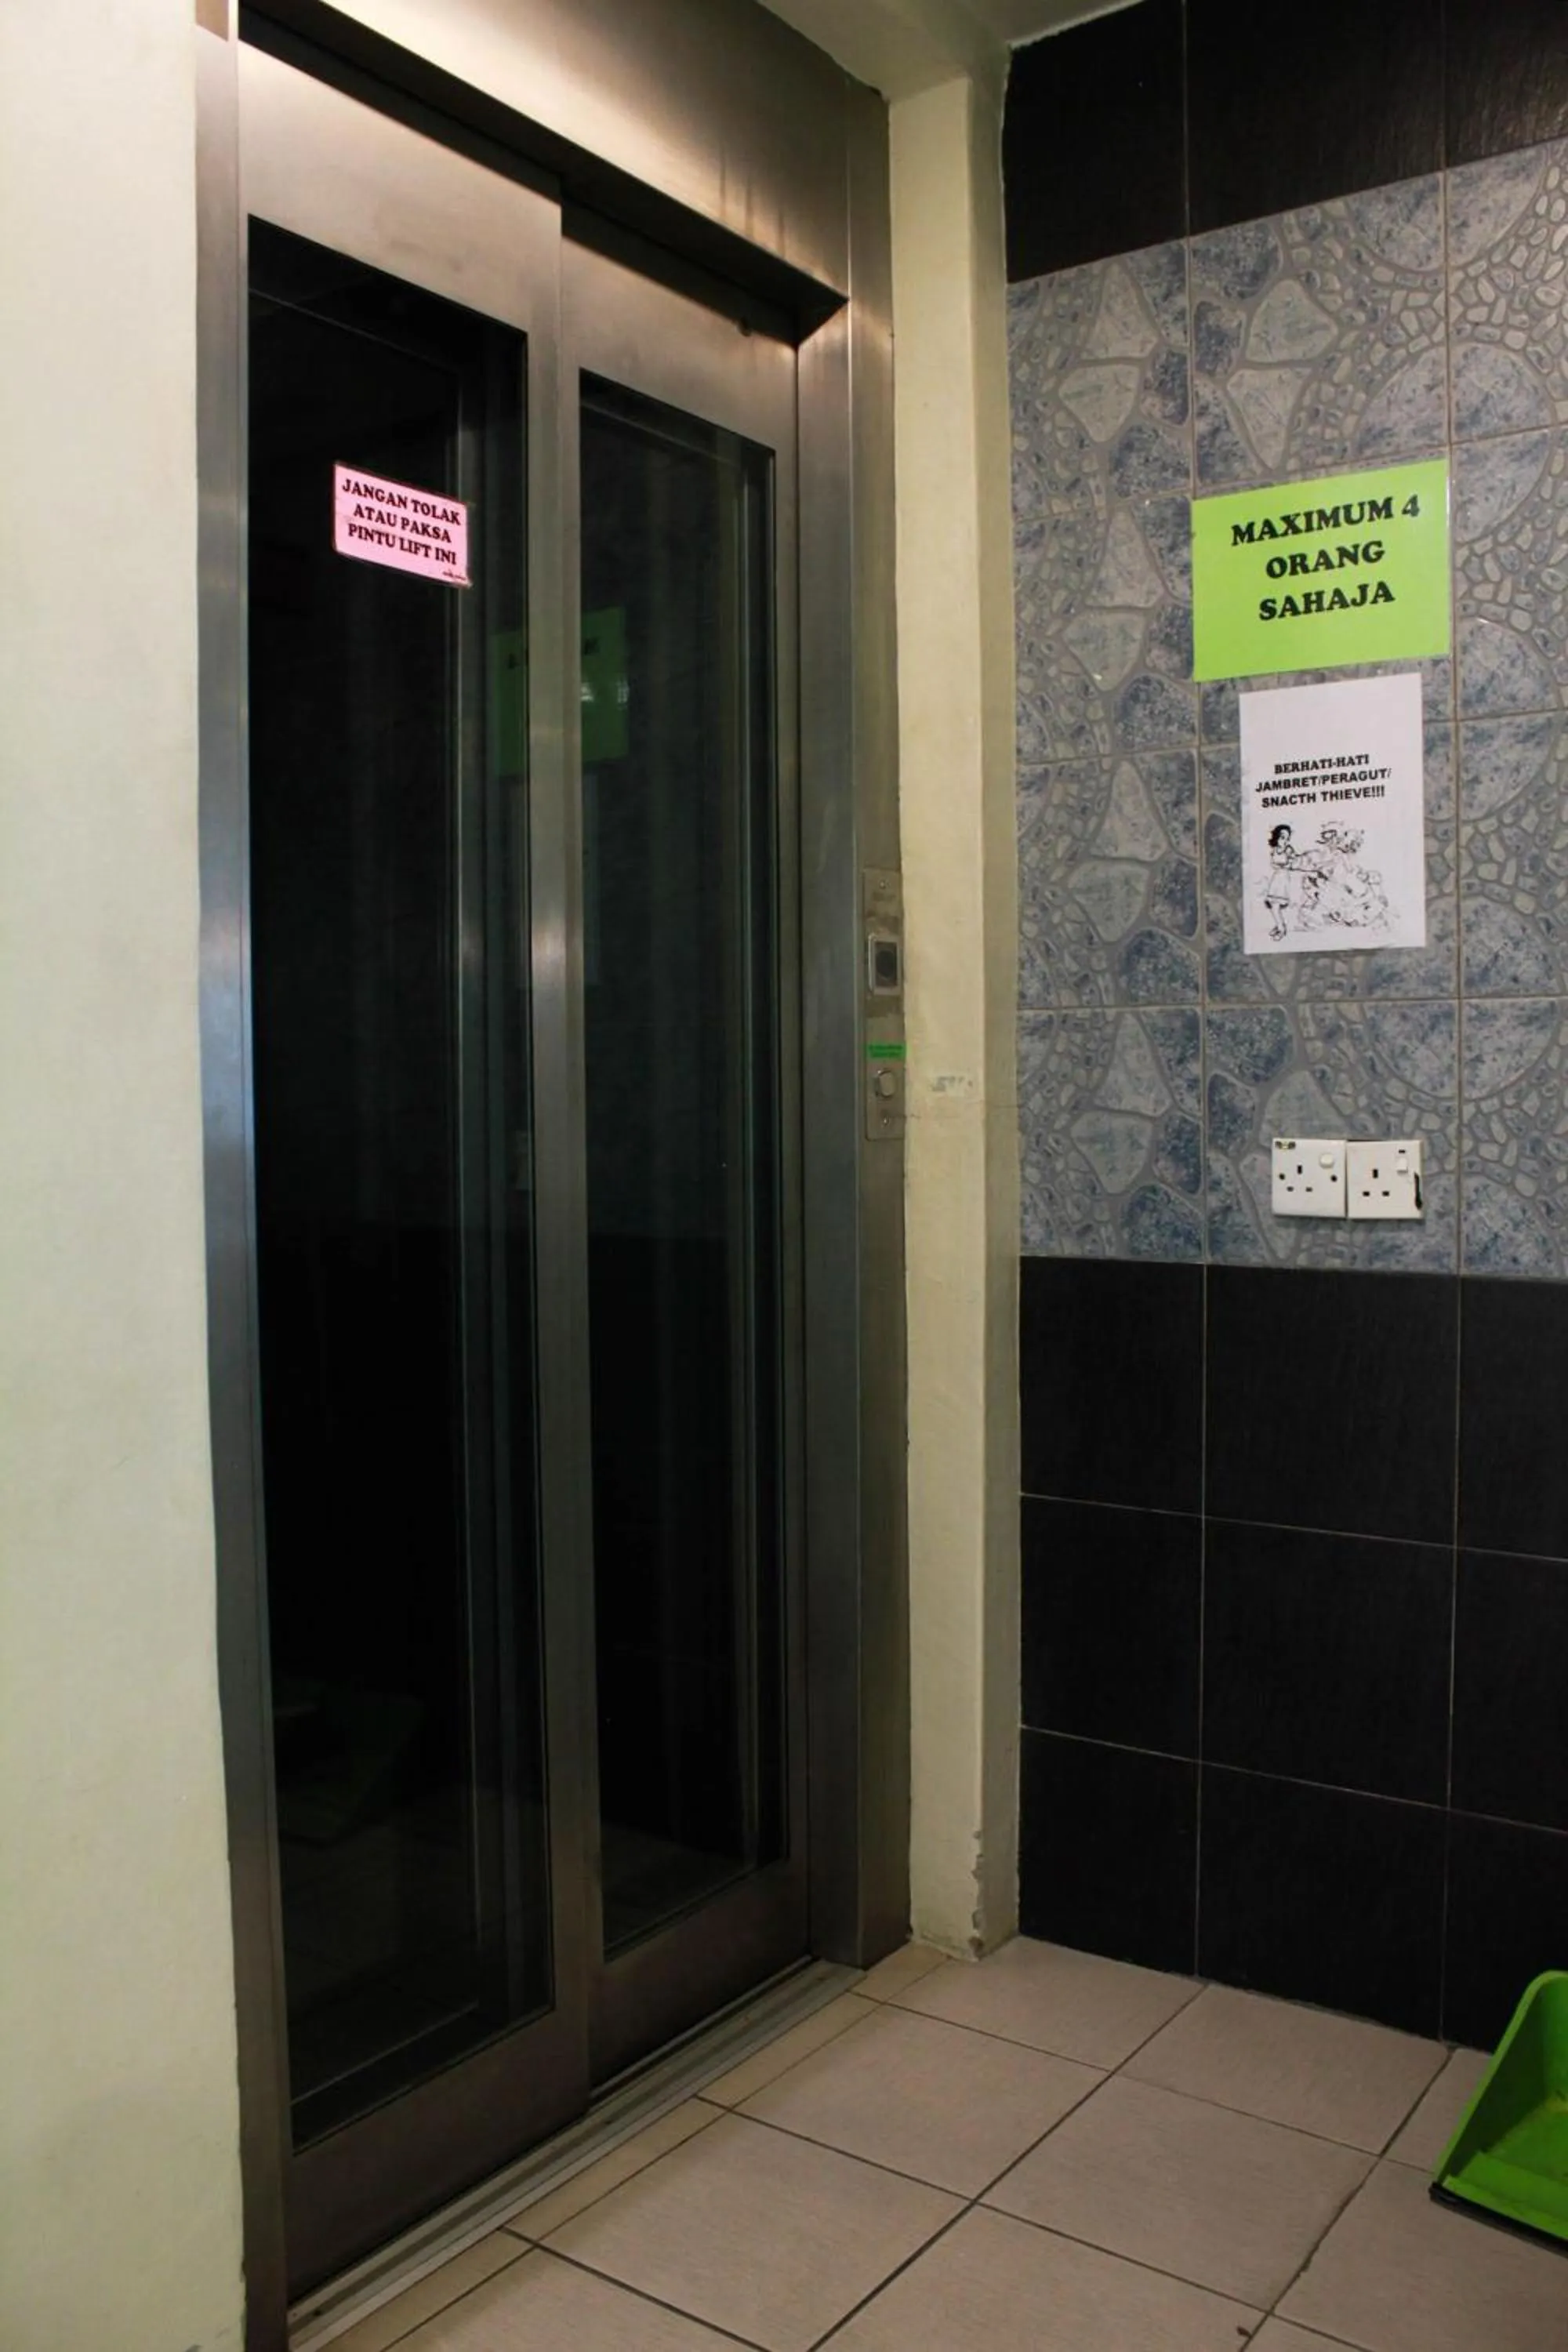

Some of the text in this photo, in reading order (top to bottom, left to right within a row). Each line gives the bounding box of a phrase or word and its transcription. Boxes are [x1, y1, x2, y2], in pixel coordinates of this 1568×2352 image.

[342, 478, 461, 525] JANGAN TOLAK
[1231, 494, 1421, 546] MAXIMUM 4
[354, 503, 452, 543] ATAU PAKSA
[348, 523, 457, 565] PINTU LIFT INI
[1265, 540, 1385, 579] ORANG
[1259, 581, 1396, 621] SAHAJA
[1274, 753, 1370, 775] BERHATI-HATI
[1261, 785, 1385, 808] SNACTH THIEVE!!!
